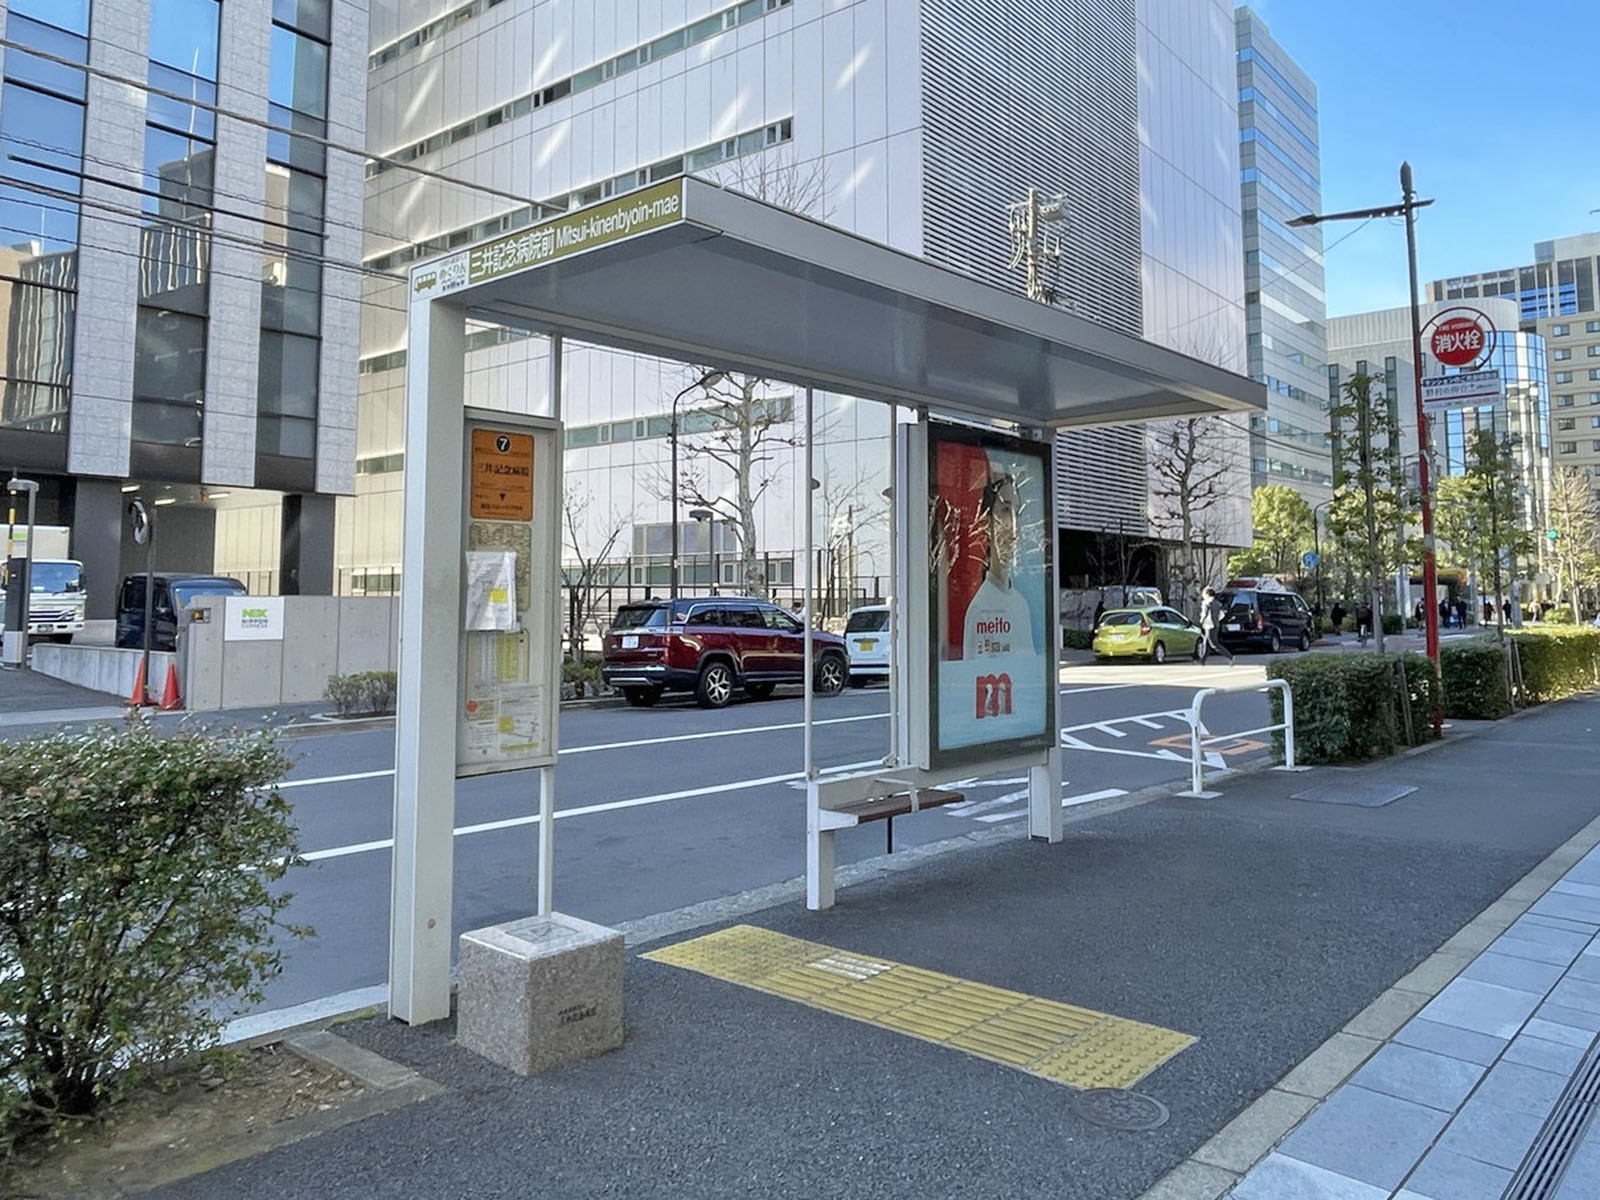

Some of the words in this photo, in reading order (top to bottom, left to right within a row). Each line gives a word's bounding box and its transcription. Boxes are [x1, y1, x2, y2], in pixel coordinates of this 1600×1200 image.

[471, 227, 555, 278] 三井記念病院前
[556, 195, 679, 249] Mitsui-kinenbyoin-mae
[1435, 329, 1481, 354] 消火栓
[499, 438, 508, 451] 7
[976, 617, 1011, 634] meito
